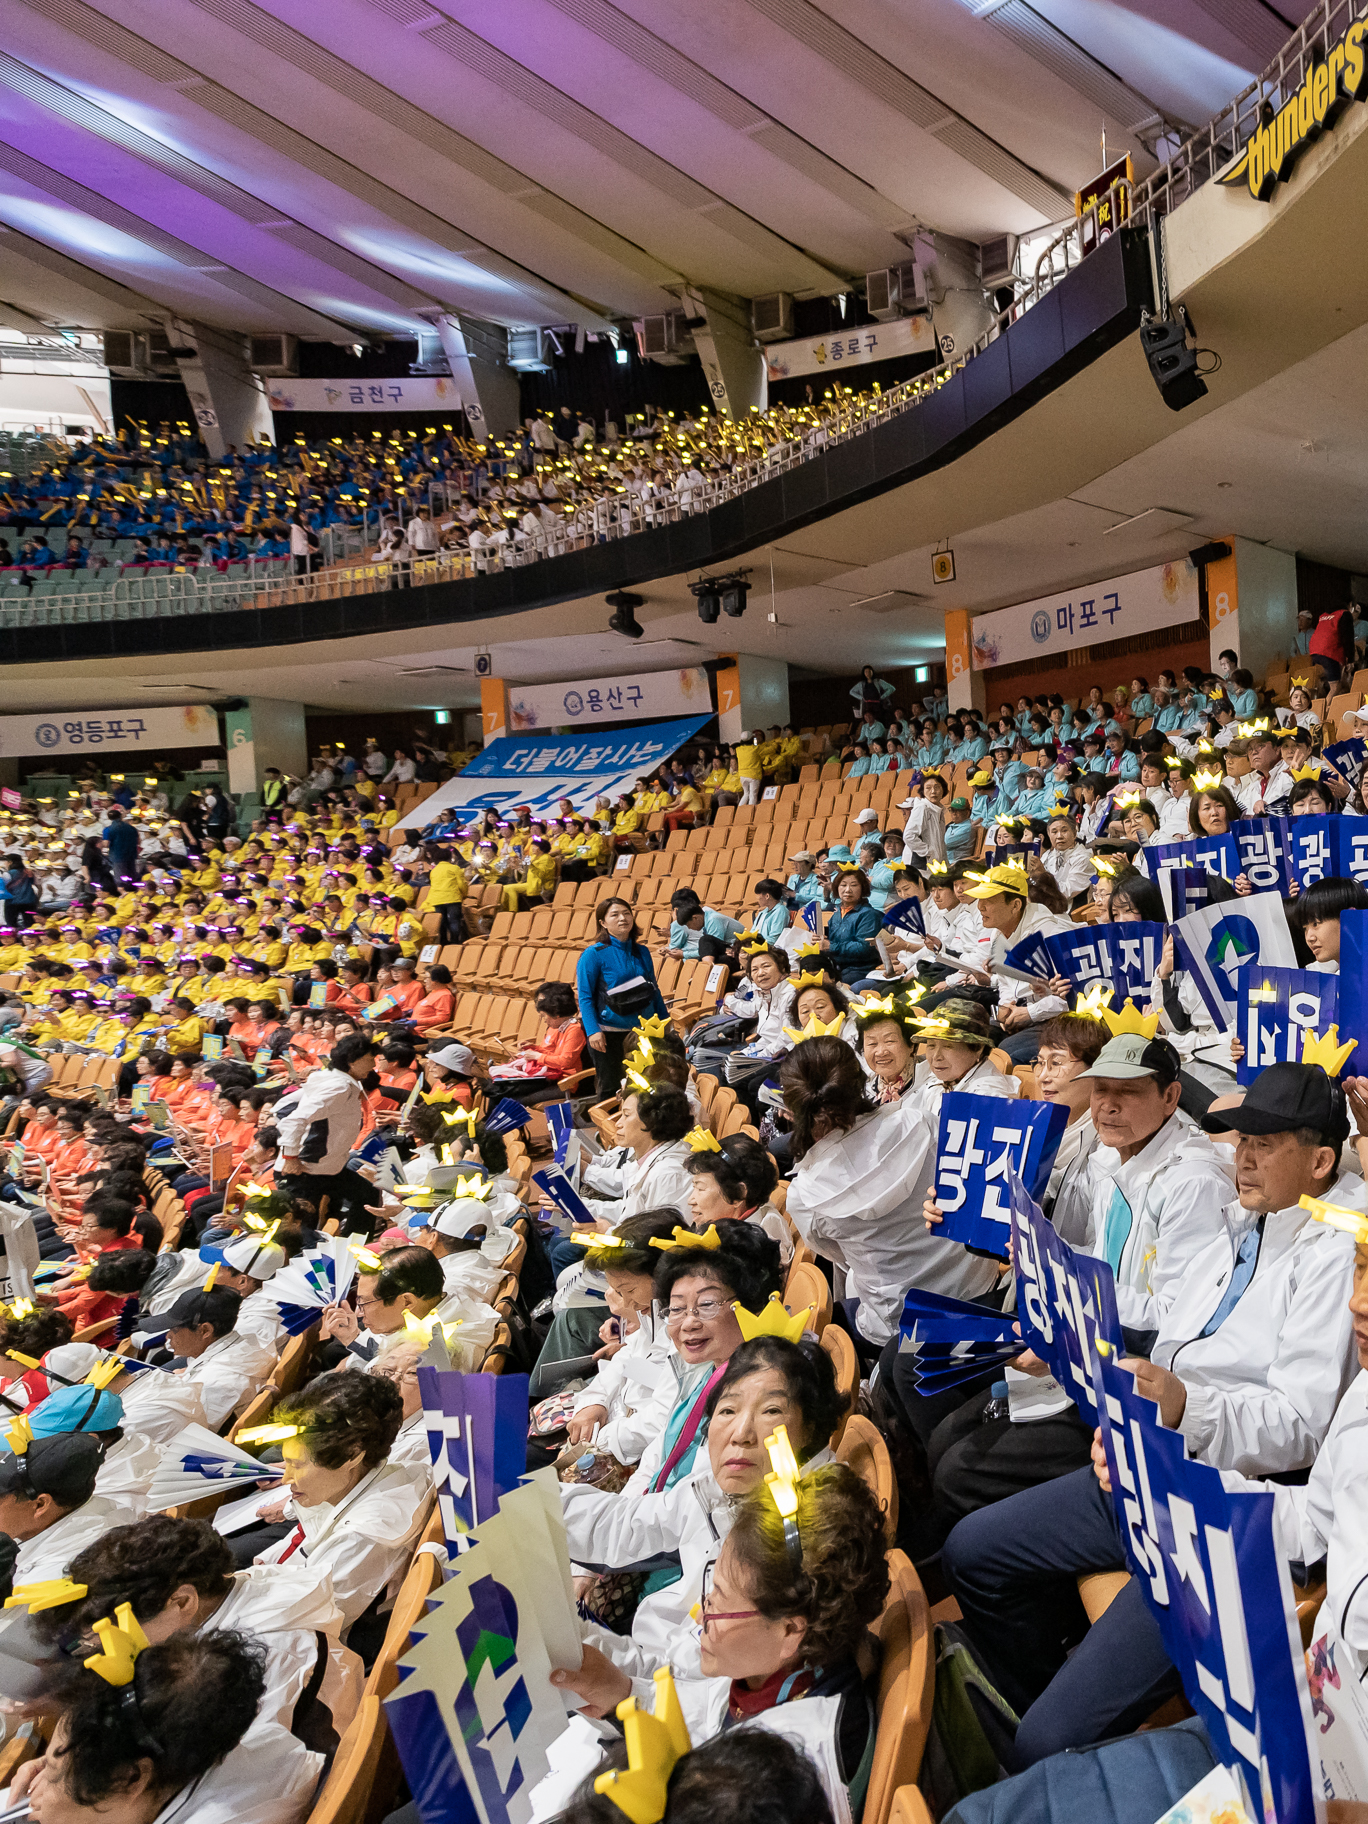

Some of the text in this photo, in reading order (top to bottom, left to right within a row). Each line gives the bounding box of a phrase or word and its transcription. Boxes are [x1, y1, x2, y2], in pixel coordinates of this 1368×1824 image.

[830, 335, 878, 360] 종로구
[941, 338, 954, 350] 25
[348, 386, 404, 404] 금천구
[712, 383, 724, 396] 25
[939, 562, 947, 573] 8
[1057, 592, 1122, 635] 마포구
[1215, 592, 1230, 621] 8
[951, 654, 963, 677] 8
[586, 685, 644, 713] 용산구
[723, 690, 733, 711] 7
[63, 719, 147, 744] 영등포구
[487, 713, 499, 731] 7
[232, 728, 246, 747] 6
[1071, 936, 1155, 998] 광진
[935, 1118, 1034, 1224] 광진
[1104, 1392, 1261, 1769] 광진
